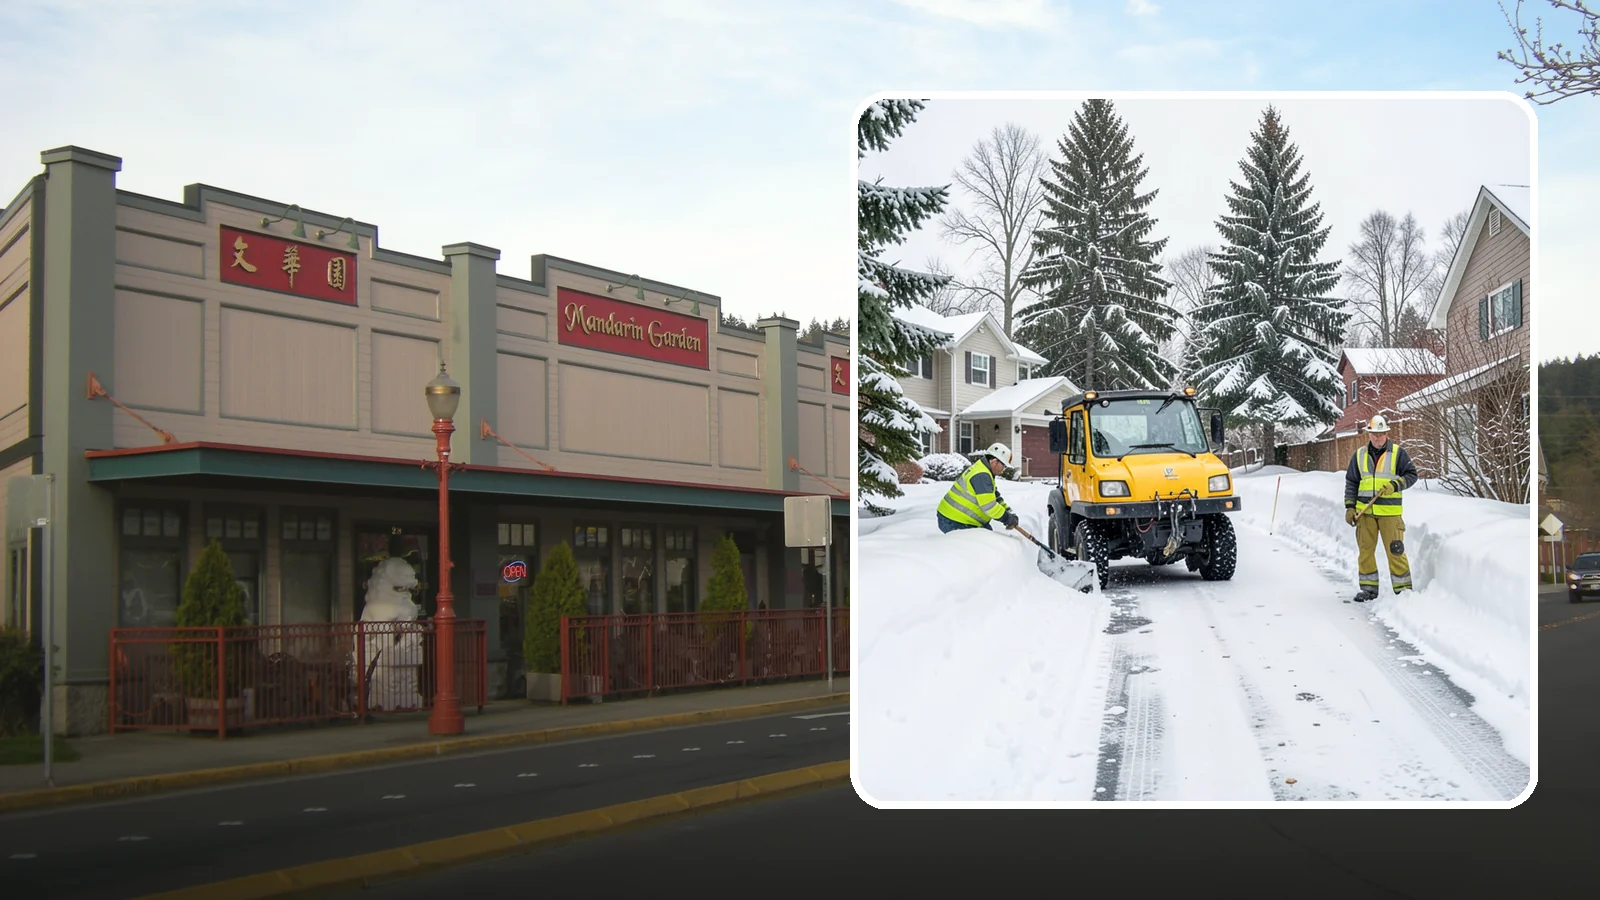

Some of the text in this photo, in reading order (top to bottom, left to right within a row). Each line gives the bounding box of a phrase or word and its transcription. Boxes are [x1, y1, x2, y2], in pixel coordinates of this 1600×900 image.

[231, 235, 346, 291] 文華園
[564, 302, 701, 352] Mandarin Garden
[503, 565, 527, 578] OPEN
